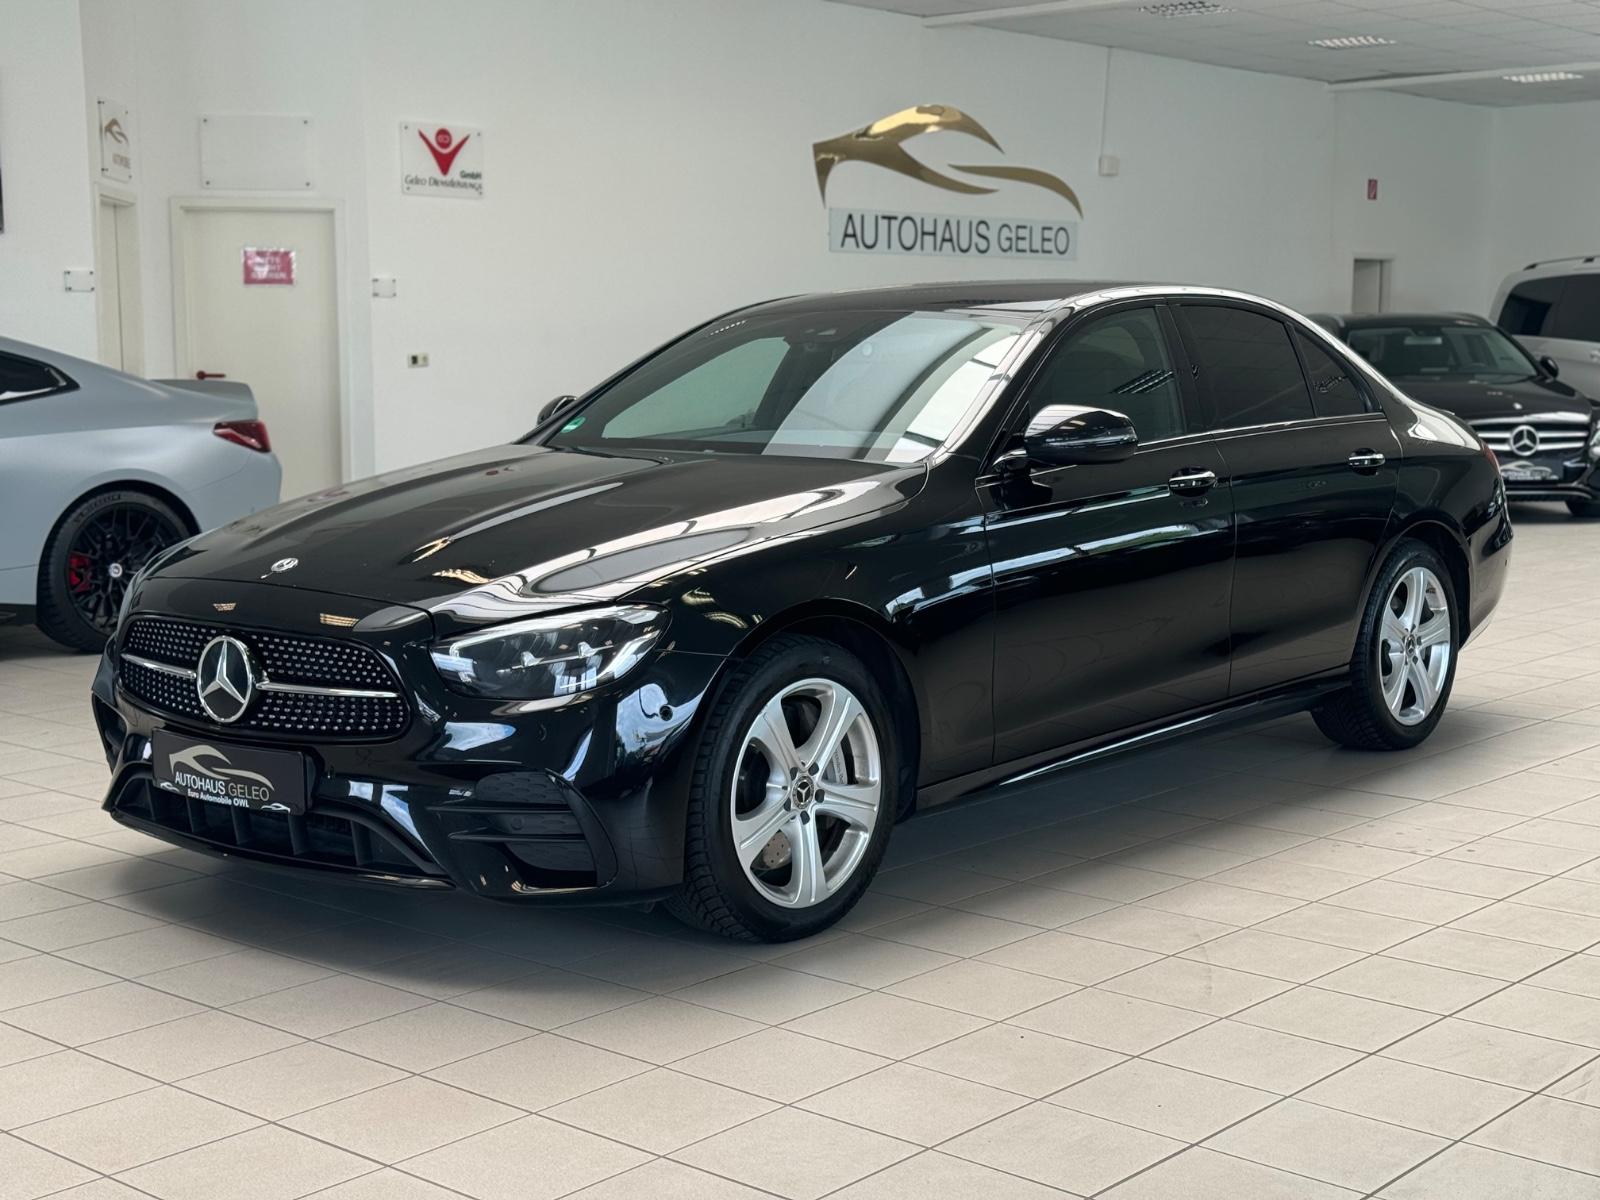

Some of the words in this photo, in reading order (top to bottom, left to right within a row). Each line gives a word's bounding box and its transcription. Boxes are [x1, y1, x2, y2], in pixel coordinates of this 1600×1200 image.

[459, 170, 482, 180] GmbH
[840, 213, 991, 254] AUTOHAUS
[997, 223, 1070, 255] GELEO
[175, 771, 226, 795] AUTOHAUS
[228, 782, 270, 802] GELEO
[187, 788, 200, 799] Euro
[199, 791, 232, 805] Automobile
[233, 797, 250, 808] OWL
